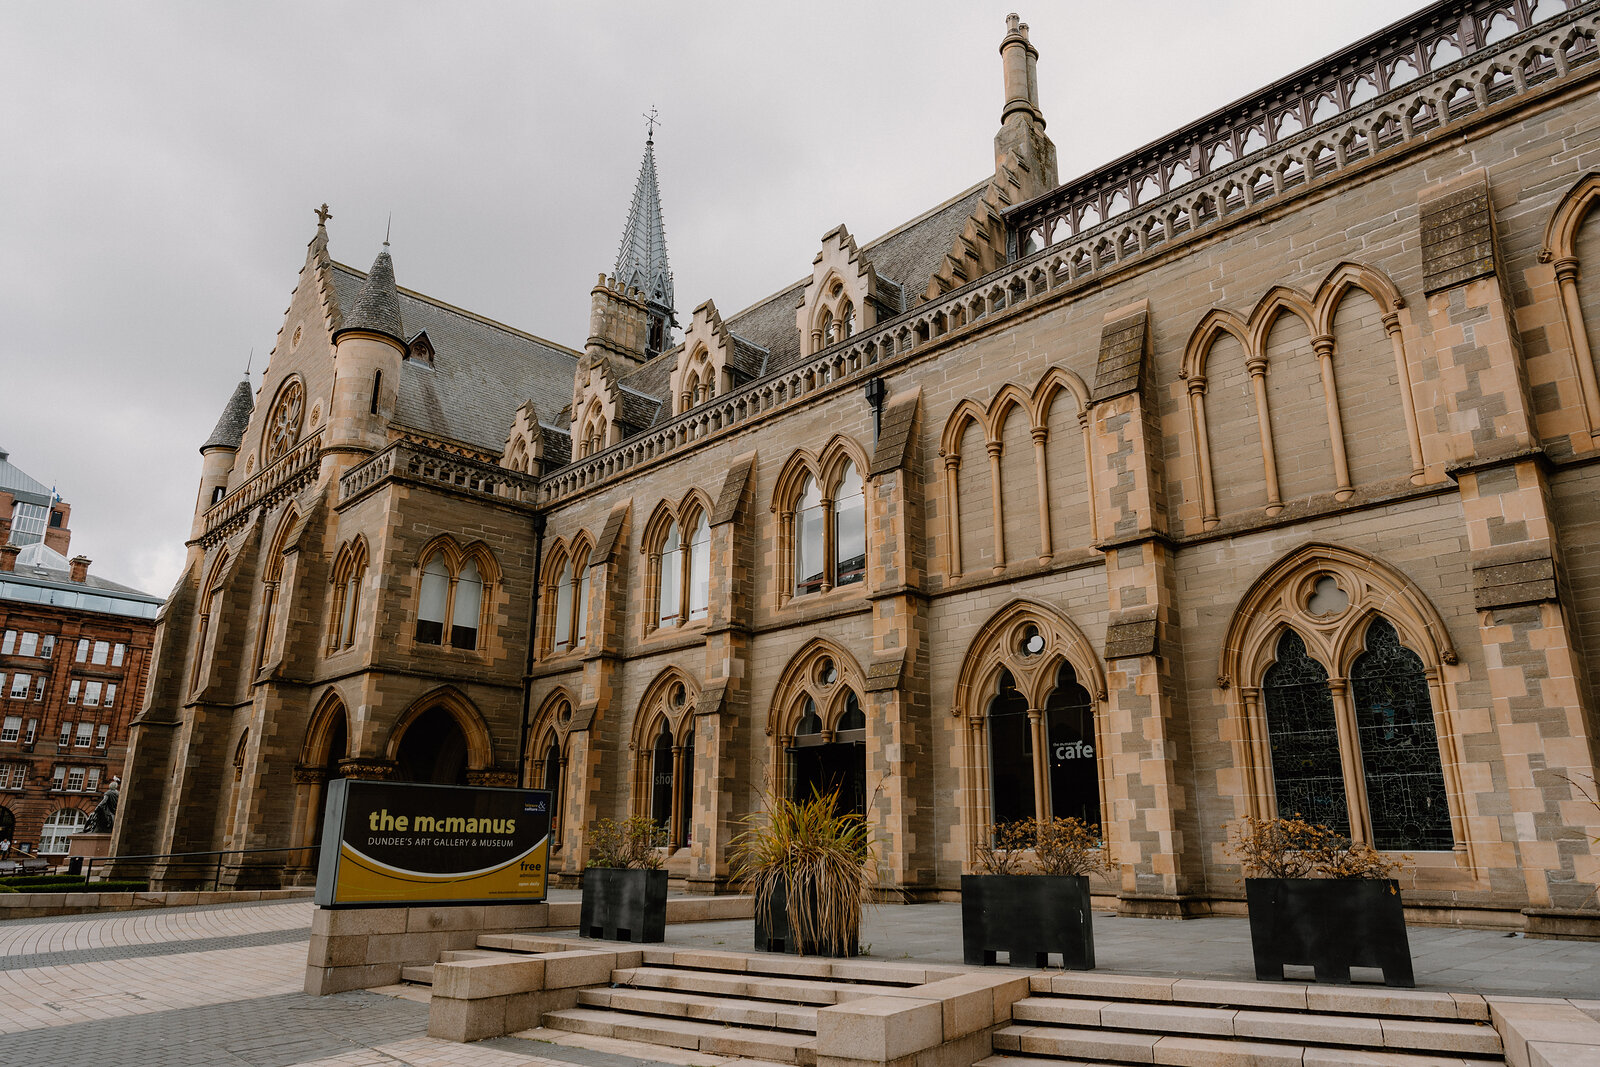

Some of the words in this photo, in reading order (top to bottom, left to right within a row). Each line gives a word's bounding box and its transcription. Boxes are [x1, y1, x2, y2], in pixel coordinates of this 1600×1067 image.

[1055, 740, 1094, 760] cafe
[368, 808, 409, 832] the
[413, 815, 516, 835] mcmanus
[367, 837, 412, 846] DUNDEE'S
[414, 838, 432, 846] ART
[433, 838, 470, 847] GALLERY
[471, 839, 478, 847] &
[479, 839, 514, 847] MUSEUM
[520, 861, 542, 871] free
